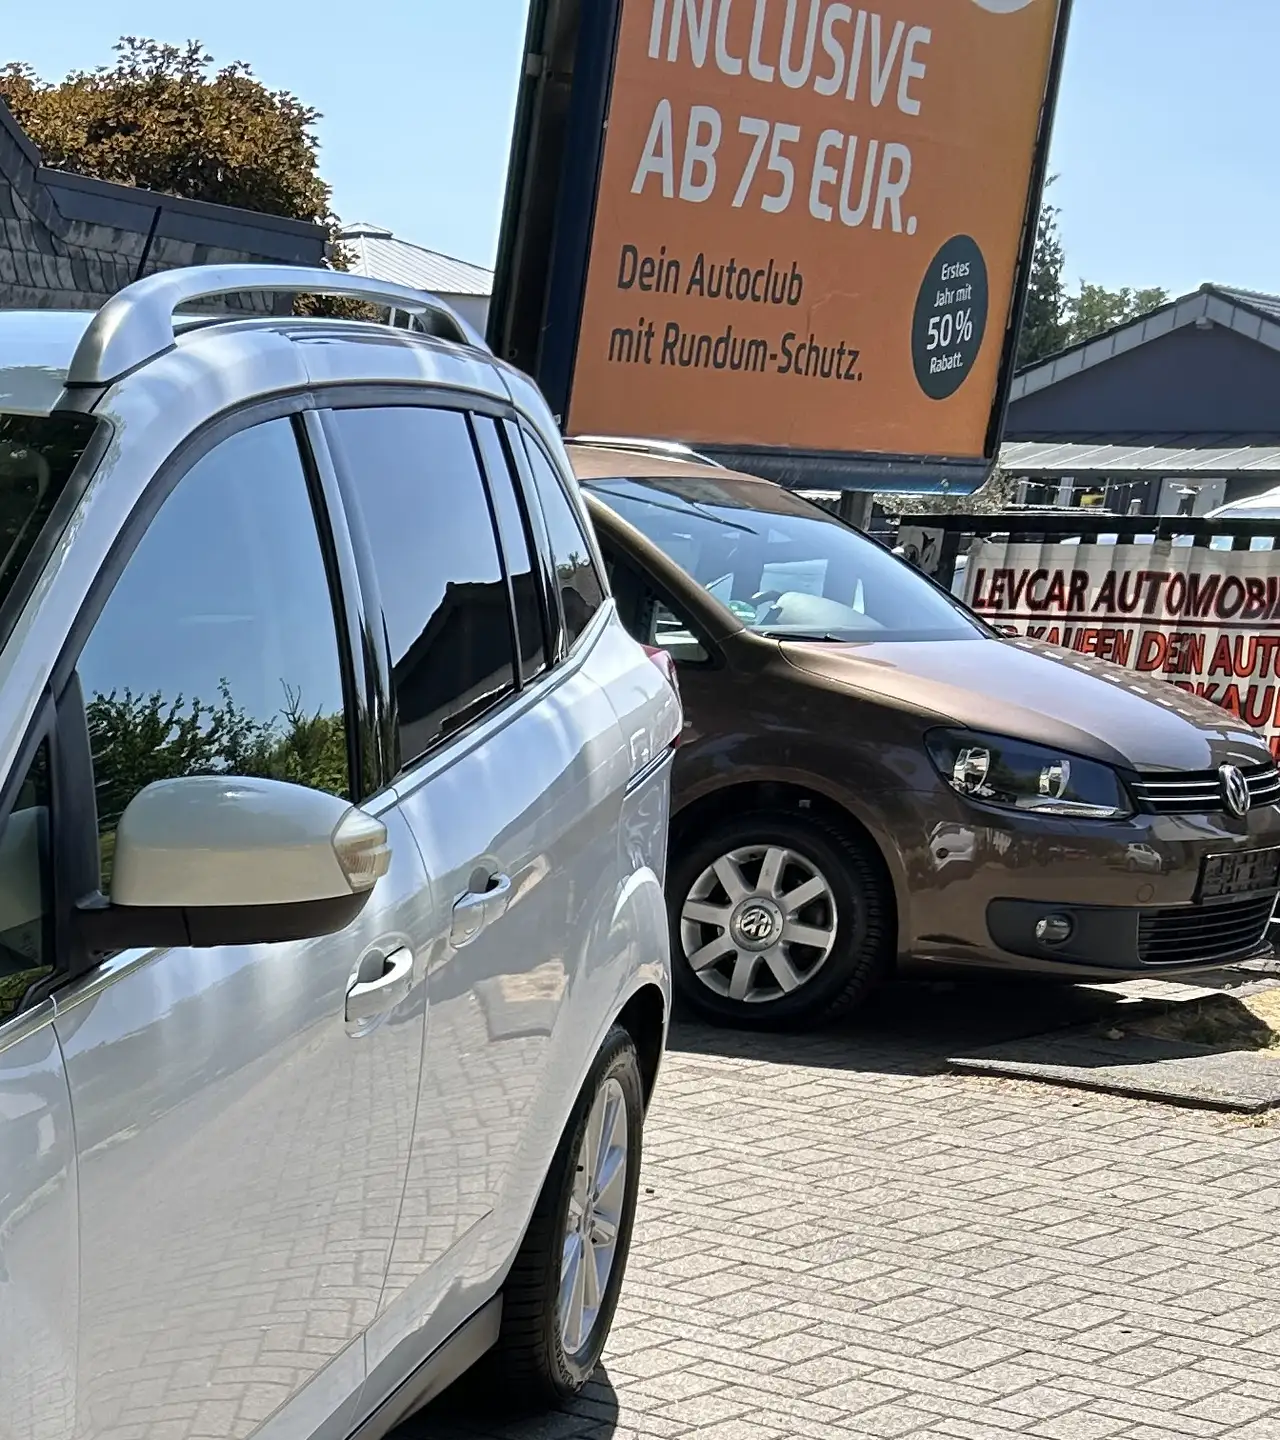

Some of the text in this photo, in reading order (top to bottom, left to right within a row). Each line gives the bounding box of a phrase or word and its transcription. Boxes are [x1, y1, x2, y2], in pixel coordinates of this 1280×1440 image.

[648, 0, 931, 116] INCLUSIVE
[630, 98, 917, 236] AB 75 EUR.
[617, 244, 803, 306] Dein Autoclub
[933, 283, 972, 307] Jahr mit
[941, 261, 970, 281] Erstes
[608, 317, 862, 382] mit Rundum-Schutz.
[971, 567, 1089, 612] LEVCAR
[1135, 630, 1204, 676] DEIN
